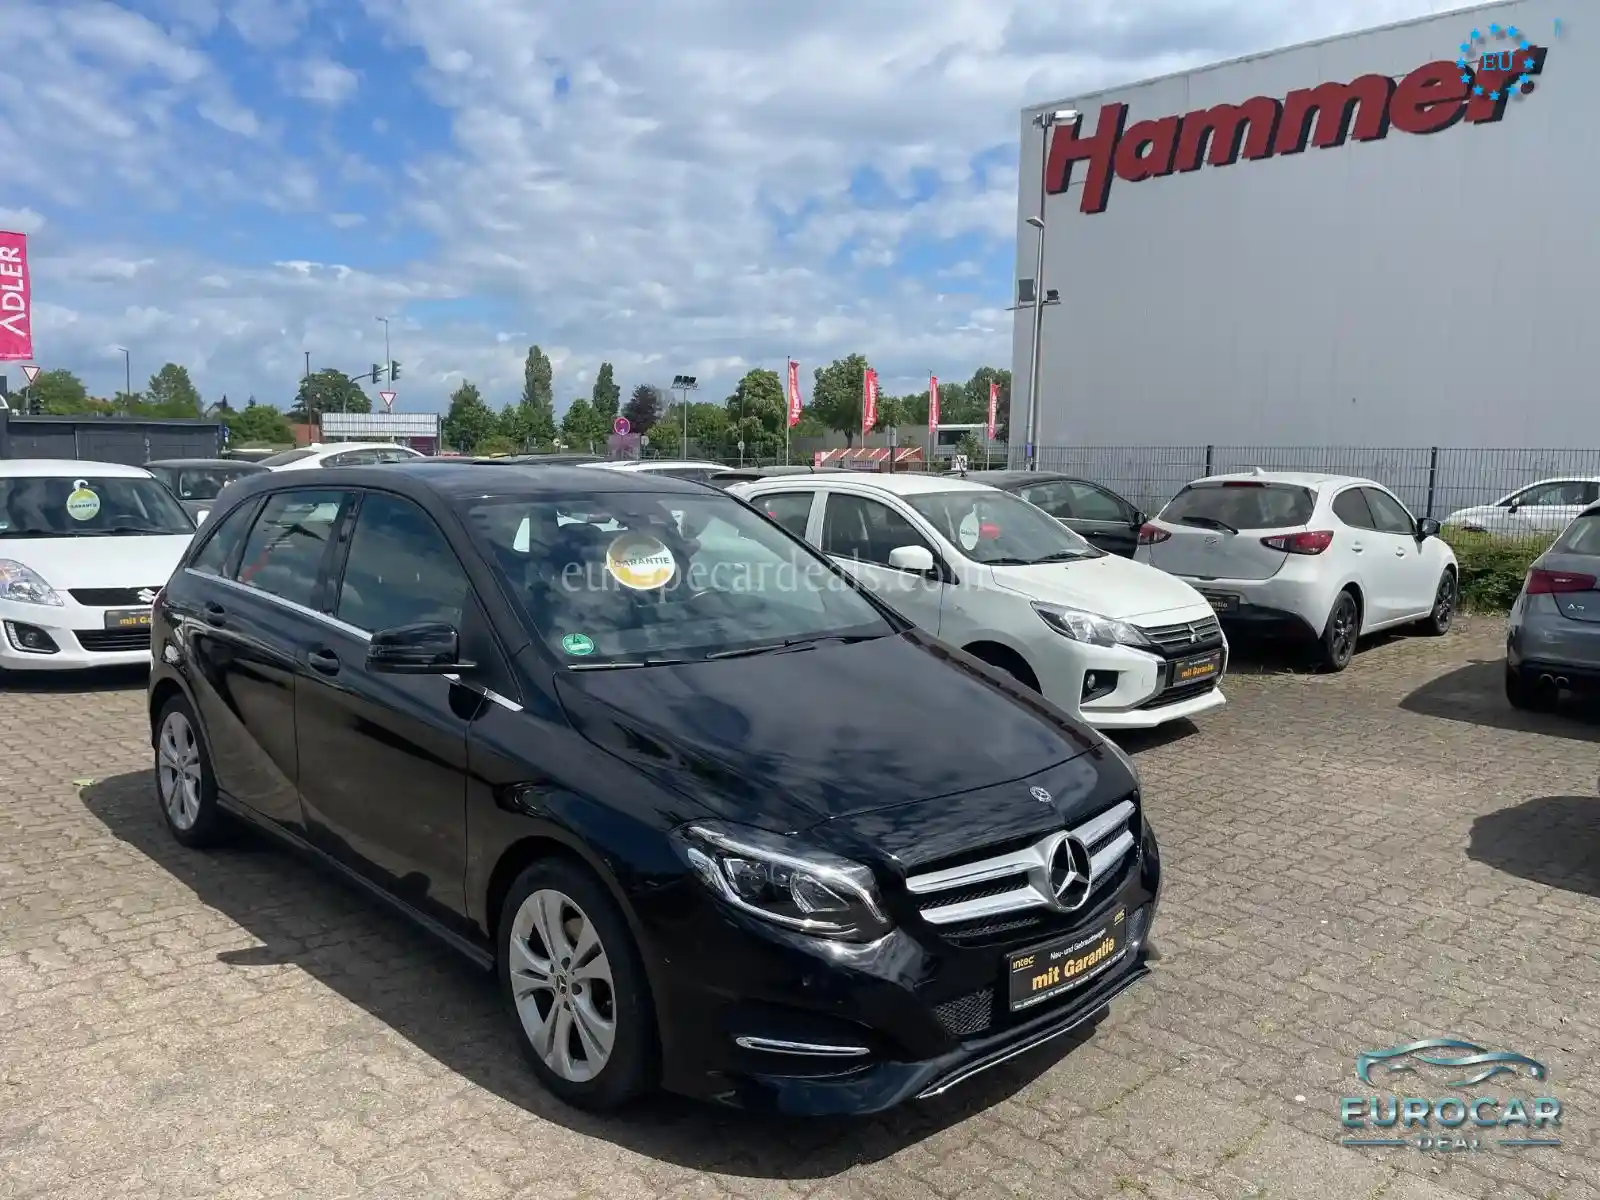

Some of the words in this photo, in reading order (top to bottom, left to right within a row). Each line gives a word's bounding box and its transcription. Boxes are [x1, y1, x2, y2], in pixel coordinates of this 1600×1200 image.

[0, 245, 26, 337] ADLER
[614, 556, 671, 568] GARANTIE
[1012, 954, 1035, 970] intec
[1032, 966, 1060, 990] mit
[1064, 938, 1115, 977] Garantie
